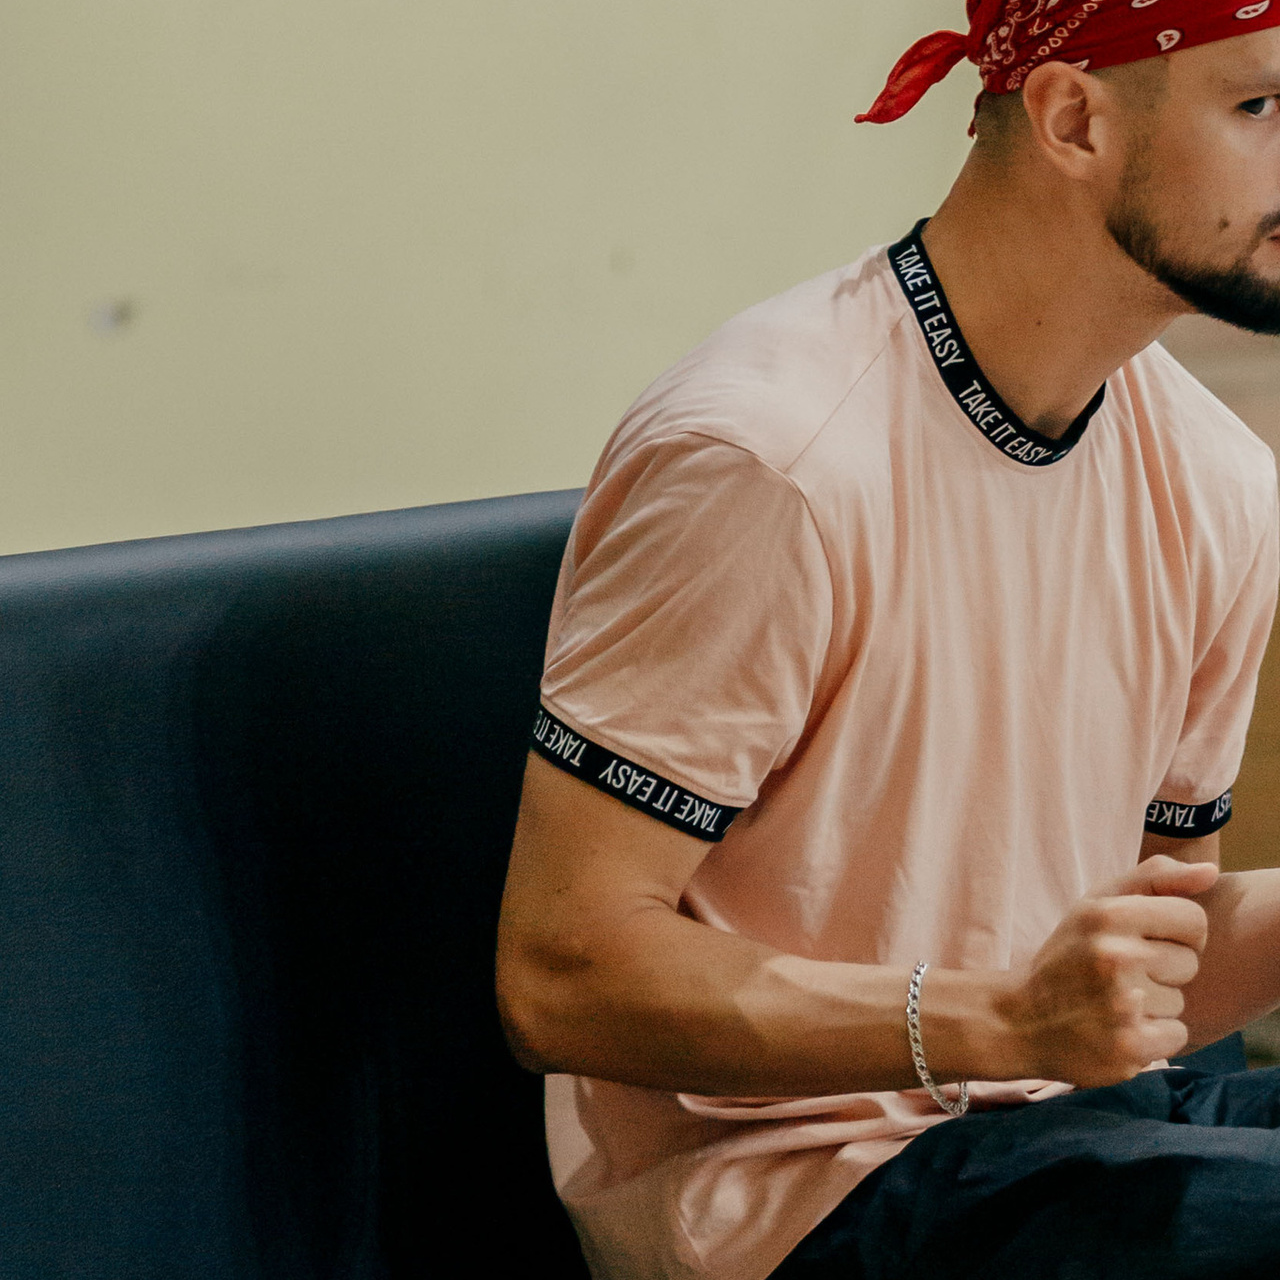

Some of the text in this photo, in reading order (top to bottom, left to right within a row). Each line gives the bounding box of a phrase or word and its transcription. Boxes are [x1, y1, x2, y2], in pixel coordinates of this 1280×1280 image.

[895, 244, 964, 367] TAKE IT EASY
[958, 379, 1053, 463] TAKE IT EASY
[544, 724, 587, 767] TAKE
[599, 759, 722, 832] TAKE IT EASY
[1146, 802, 1197, 827] TAKE
